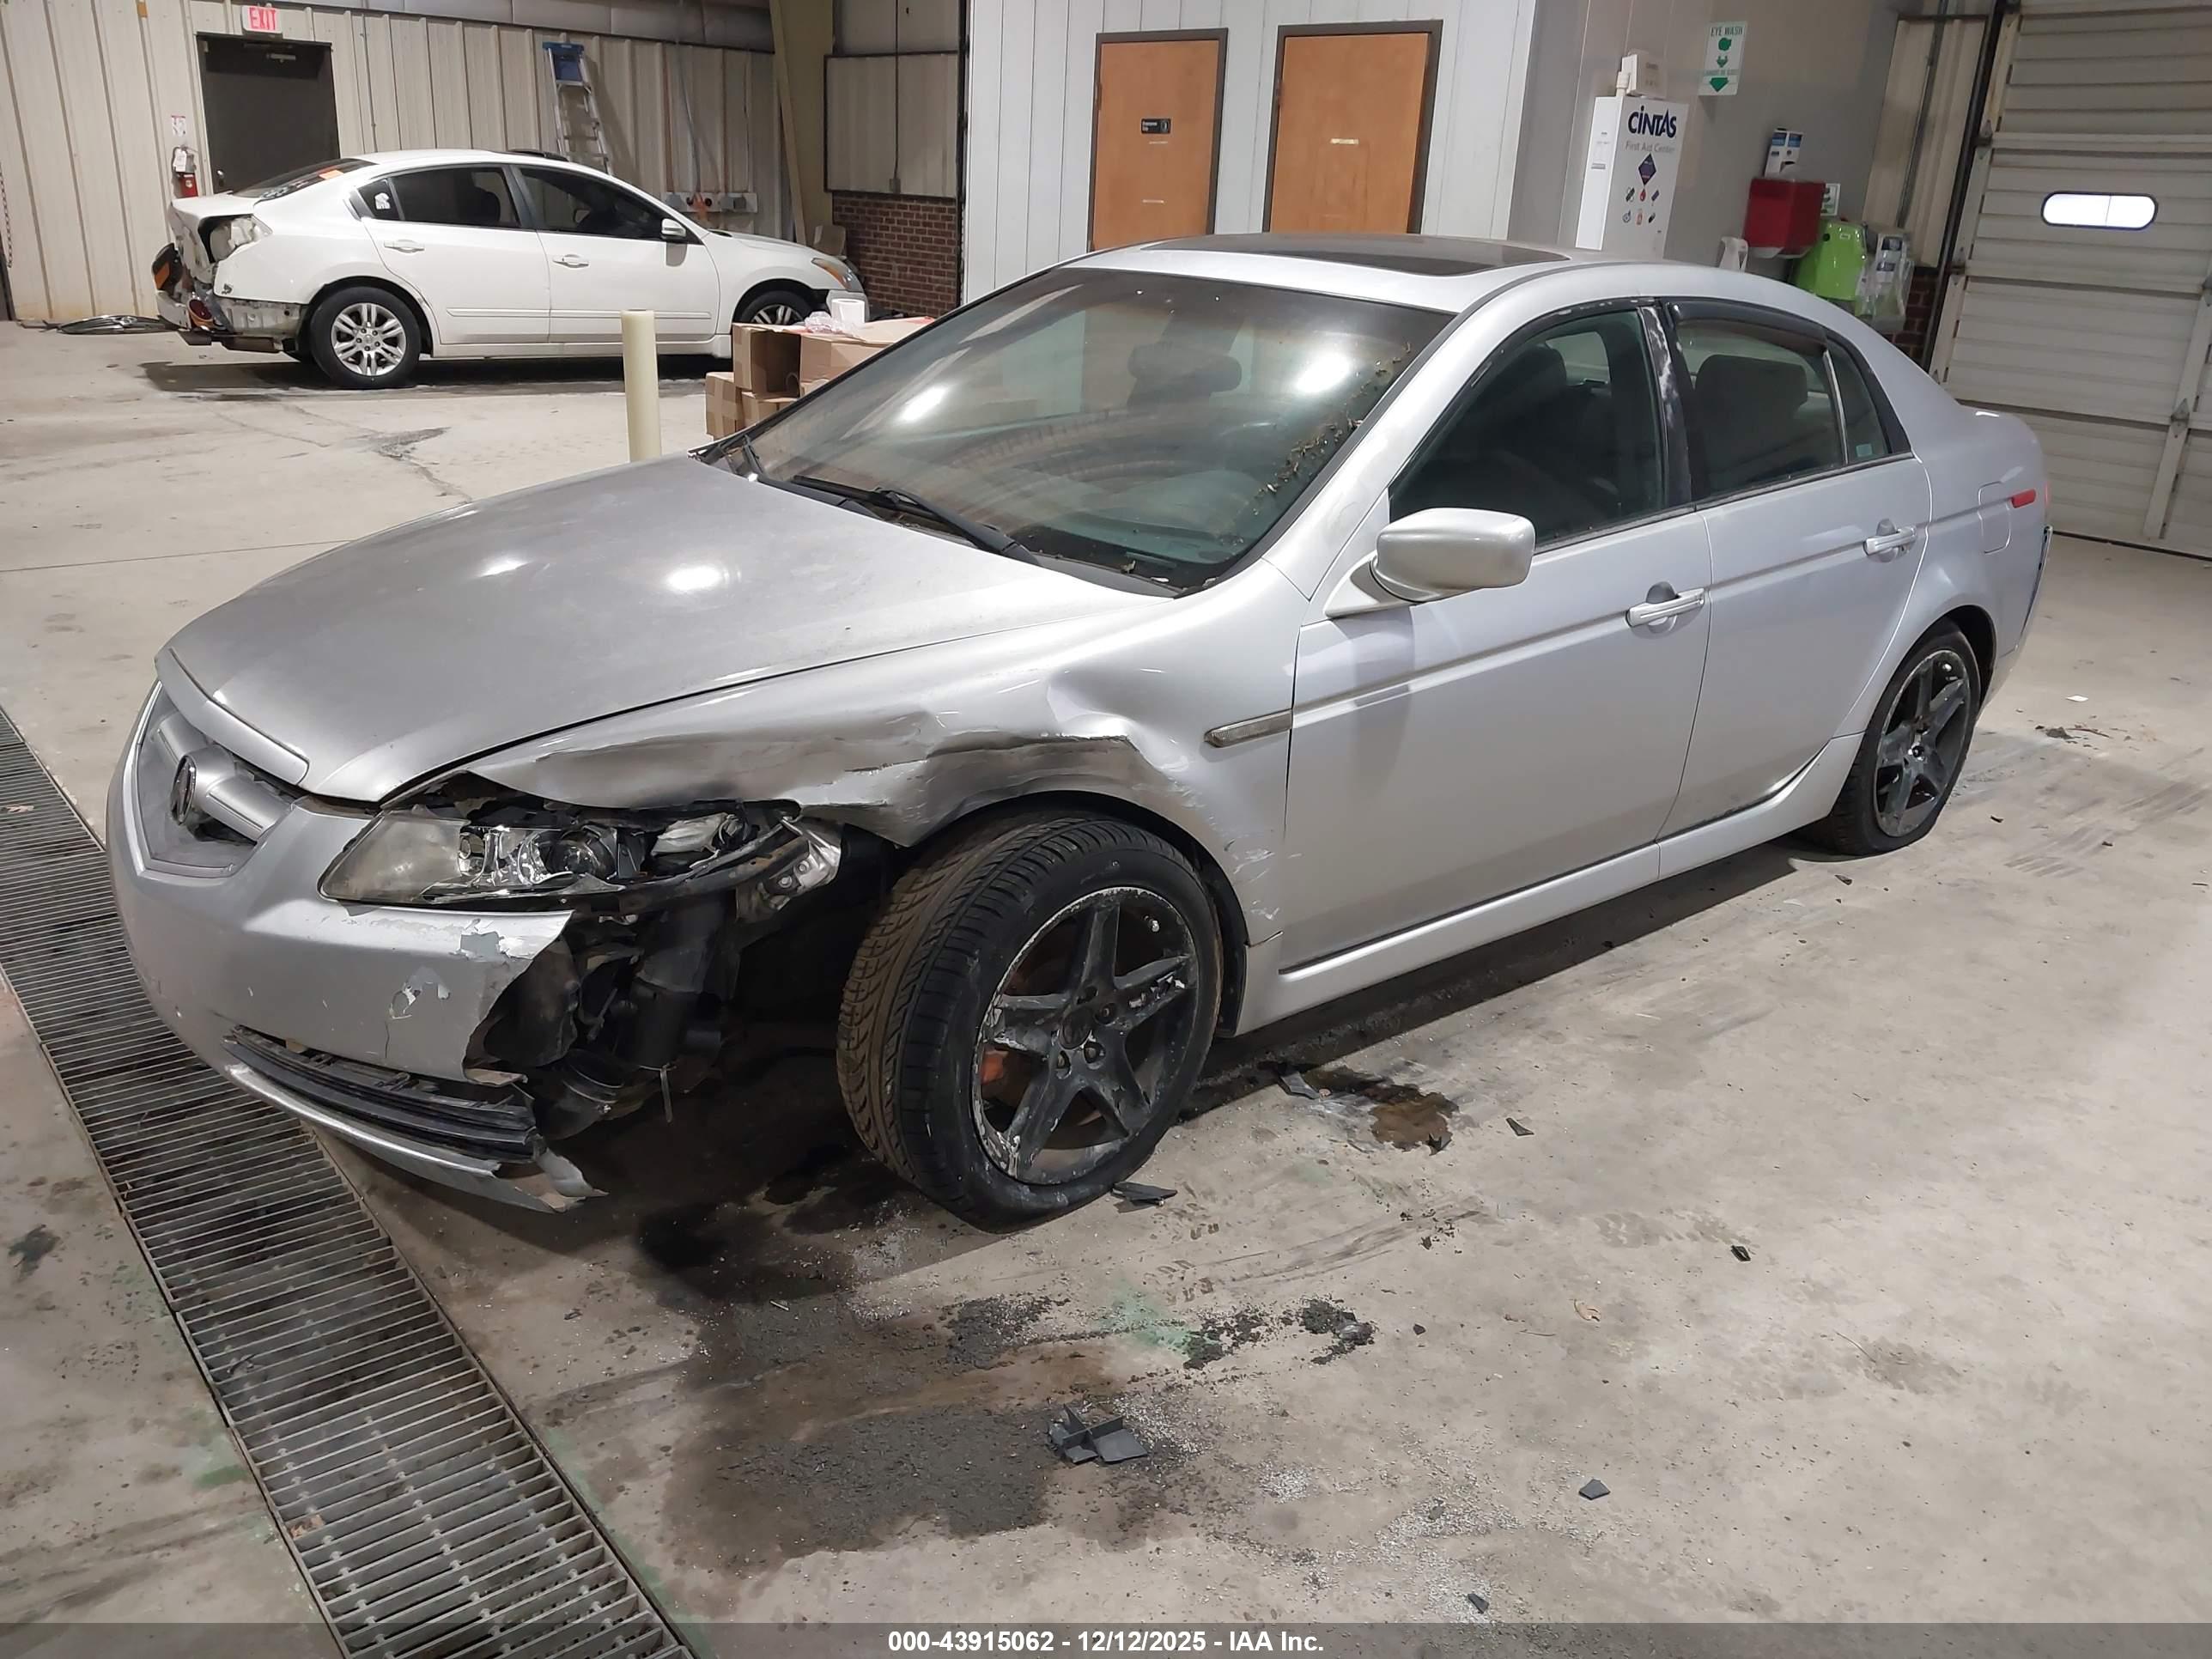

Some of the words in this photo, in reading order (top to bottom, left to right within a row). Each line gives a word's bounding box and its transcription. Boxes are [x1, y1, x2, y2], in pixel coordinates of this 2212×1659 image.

[249, 7, 276, 30] EXIT
[1711, 27, 1723, 37] EYE
[1724, 26, 1743, 35] WASH
[1626, 140, 1640, 151] First
[1642, 143, 1653, 152] Aid
[1654, 143, 1675, 153] Center
